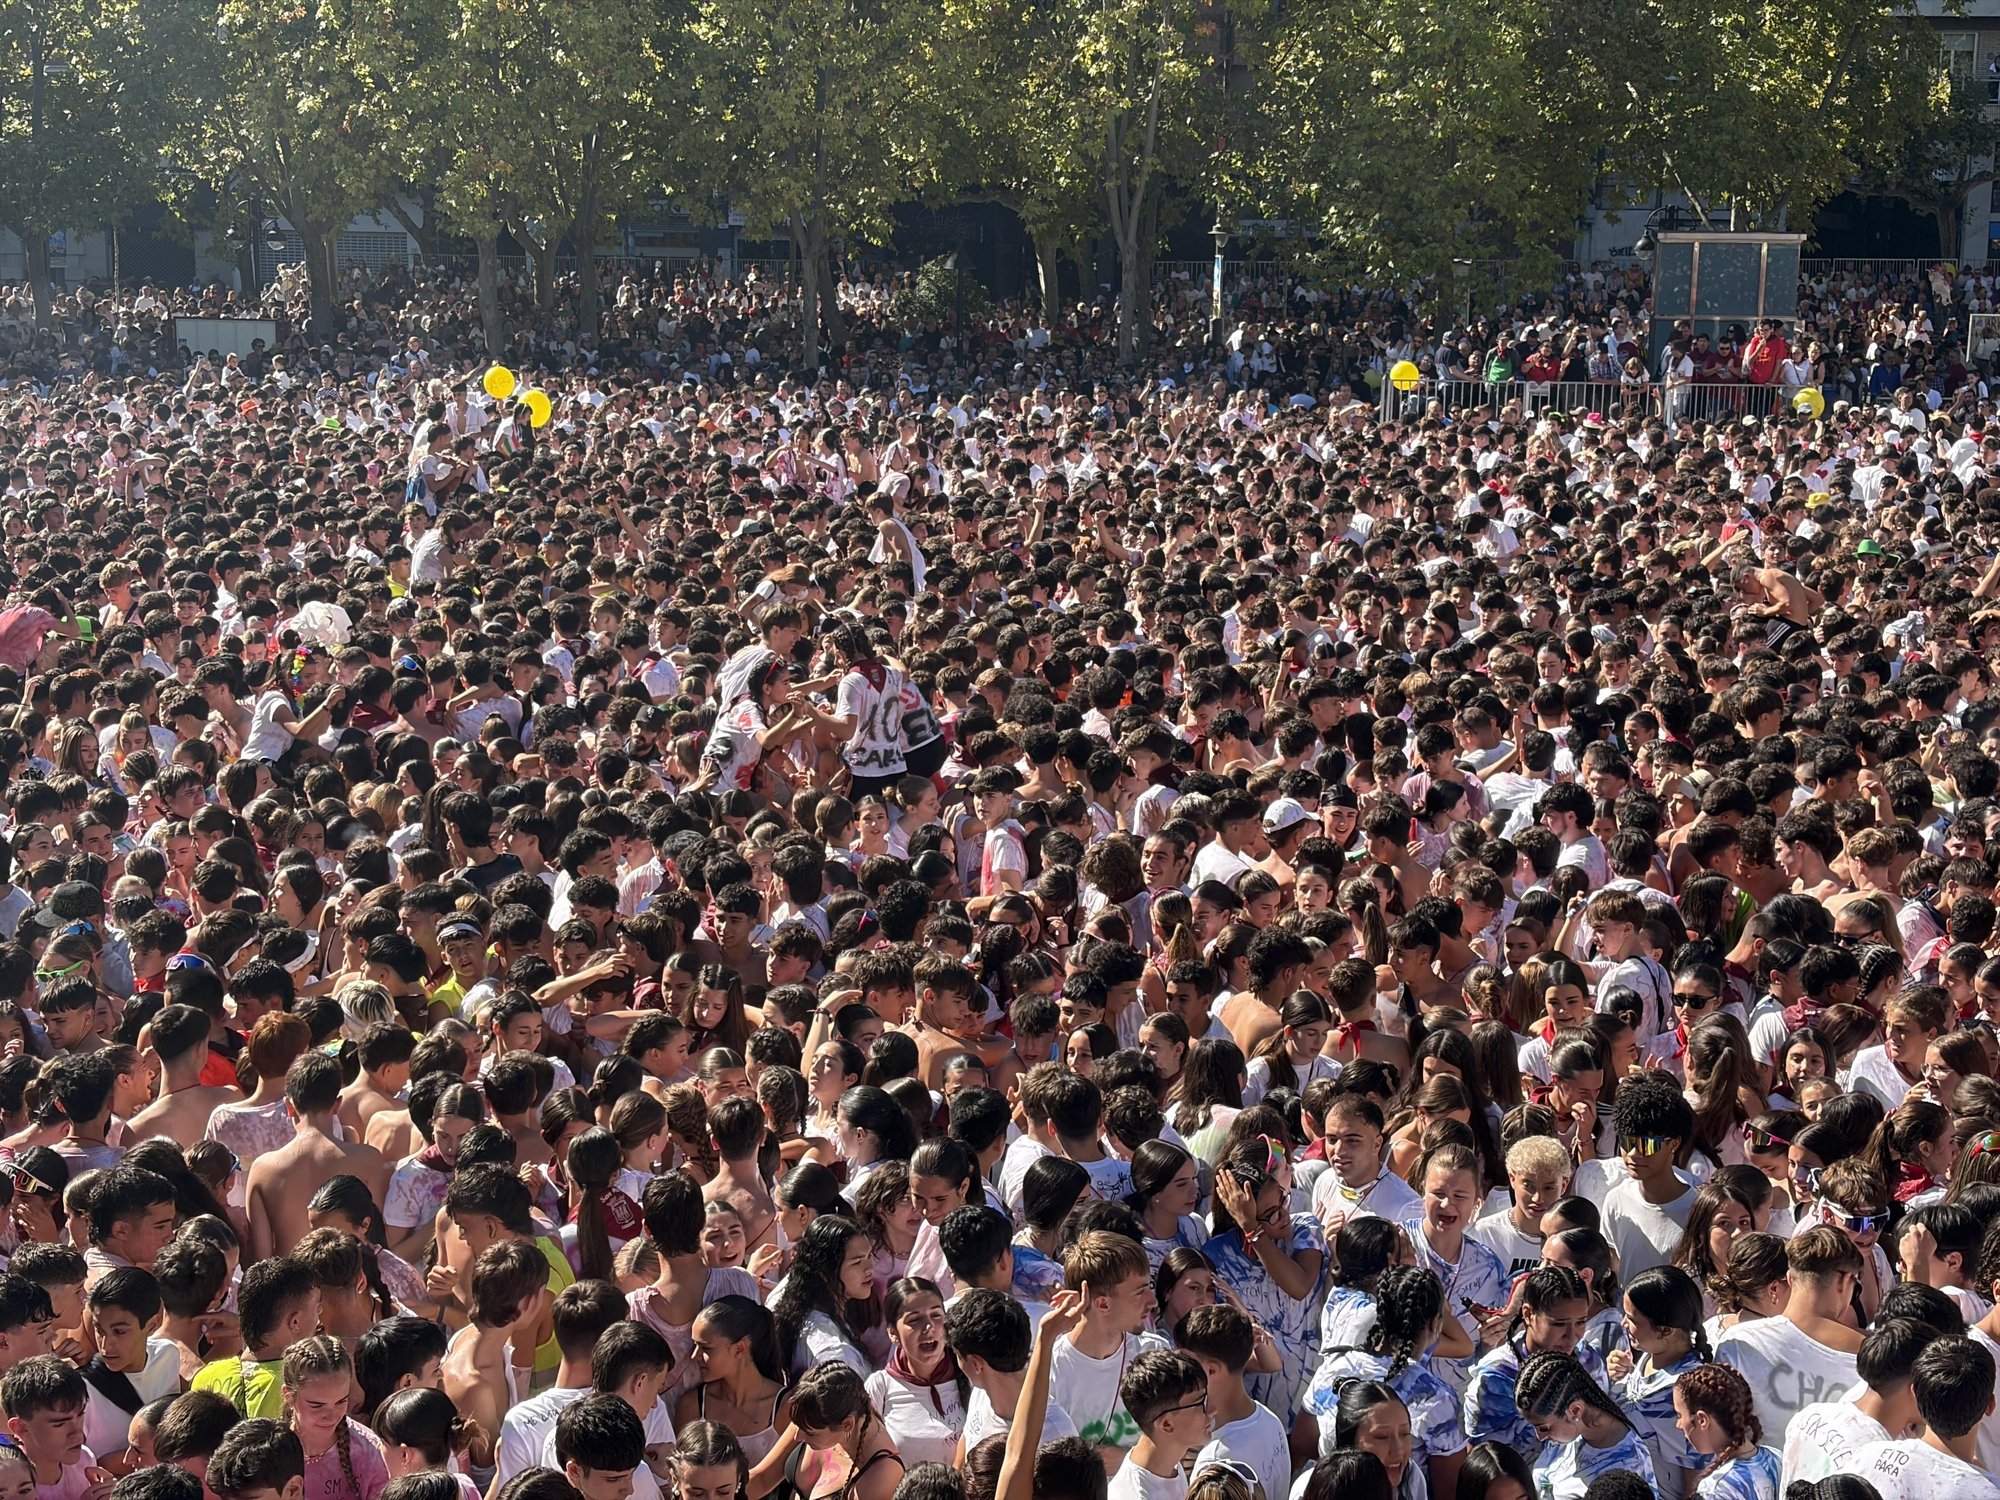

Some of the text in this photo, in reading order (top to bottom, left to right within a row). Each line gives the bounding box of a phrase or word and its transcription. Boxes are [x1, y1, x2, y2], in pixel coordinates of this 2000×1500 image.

[860, 696, 898, 743] 10
[1507, 1258, 1541, 1277] NIK
[1801, 1413, 1828, 1440] SIX
[1874, 1459, 1899, 1477] PARA
